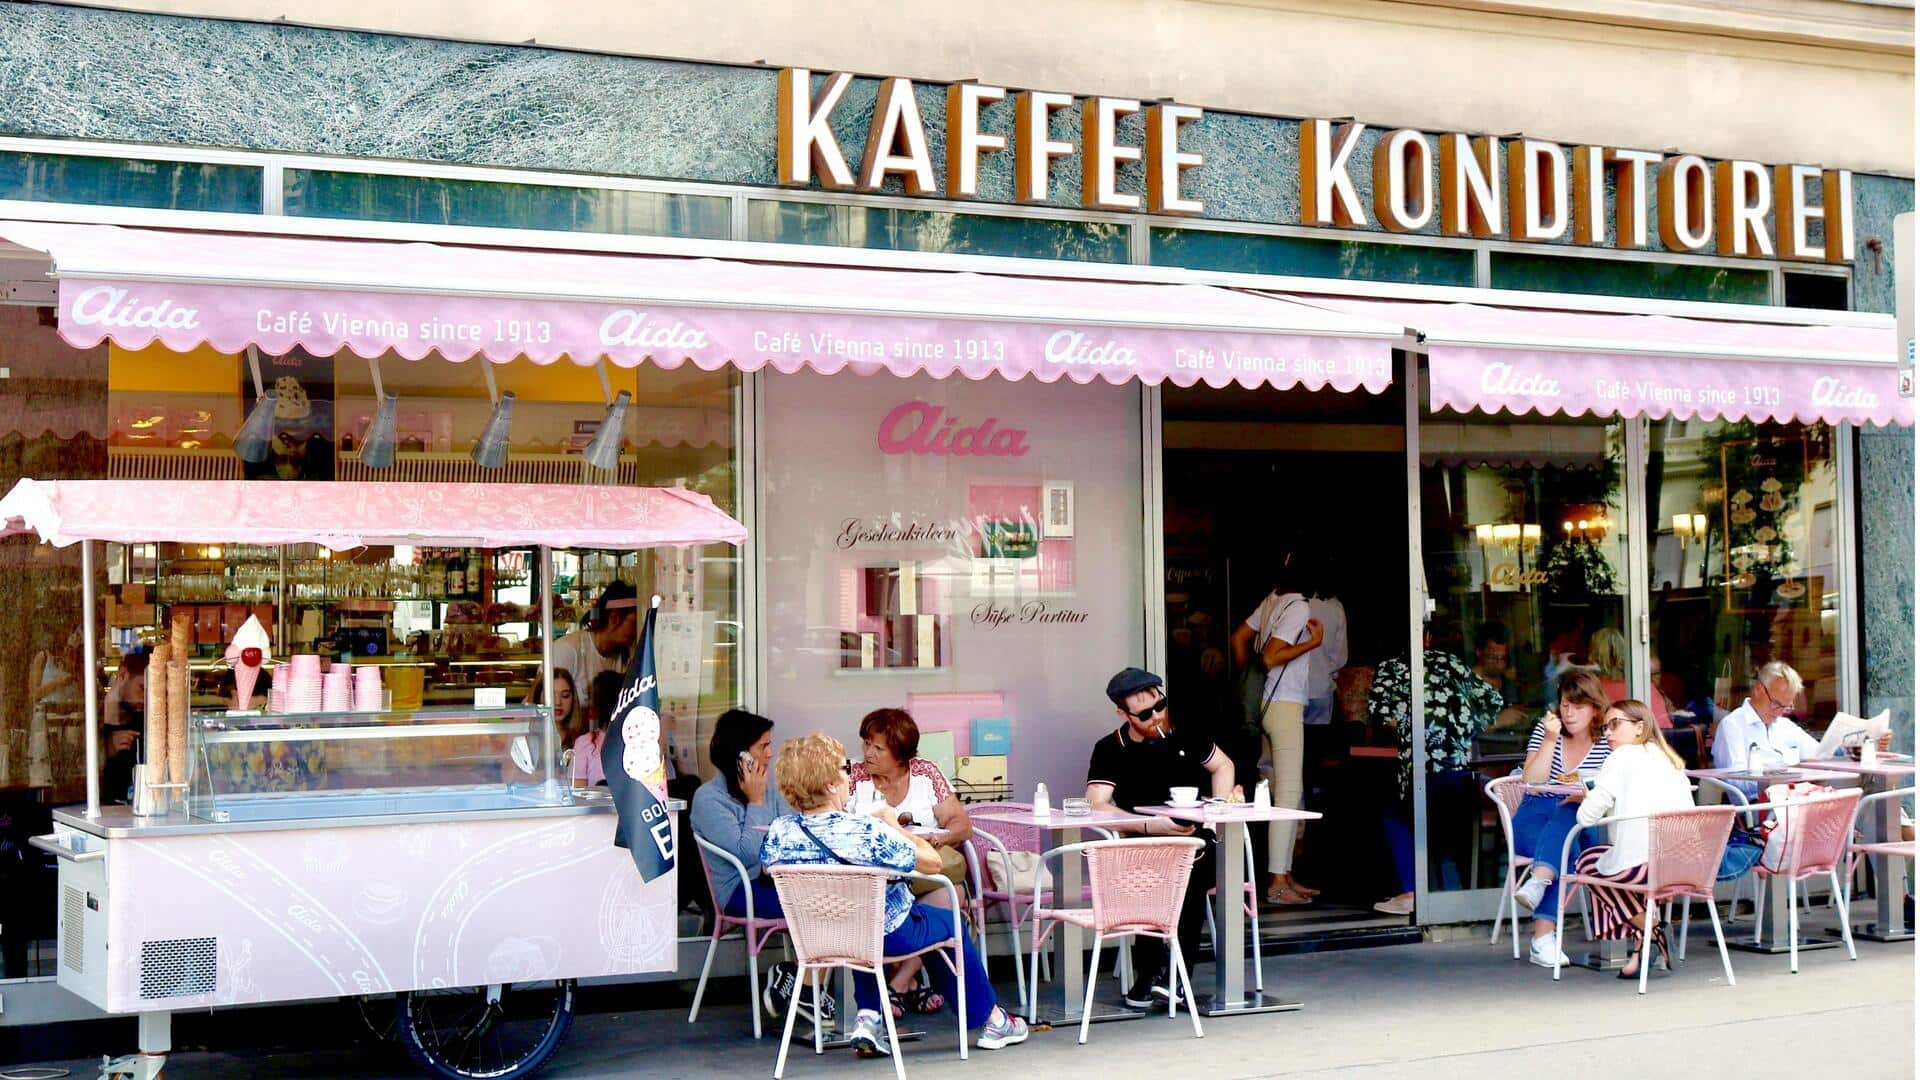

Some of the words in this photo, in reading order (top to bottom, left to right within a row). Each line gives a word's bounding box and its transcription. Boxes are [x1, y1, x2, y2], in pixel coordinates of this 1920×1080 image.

[791, 67, 1204, 213] KAFFEE
[1313, 118, 1855, 261] KONDITOREI
[256, 309, 313, 335] Café
[322, 312, 410, 339] Vienna
[420, 316, 483, 341] since
[493, 319, 551, 344] 1913
[753, 330, 801, 354] Café
[809, 333, 885, 358] Vienna
[894, 336, 945, 360] since
[953, 338, 1006, 361] 1913
[1175, 348, 1215, 370] Café
[1222, 351, 1286, 373] Vienna
[1294, 354, 1336, 375] since
[1344, 355, 1386, 377] 1913
[1596, 378, 1631, 400] Café
[1636, 382, 1693, 404] Vienna
[1698, 384, 1737, 405] since
[1743, 386, 1781, 407] 1913
[836, 517, 957, 550] Geschenkideen
[1019, 599, 1089, 625] Partitur
